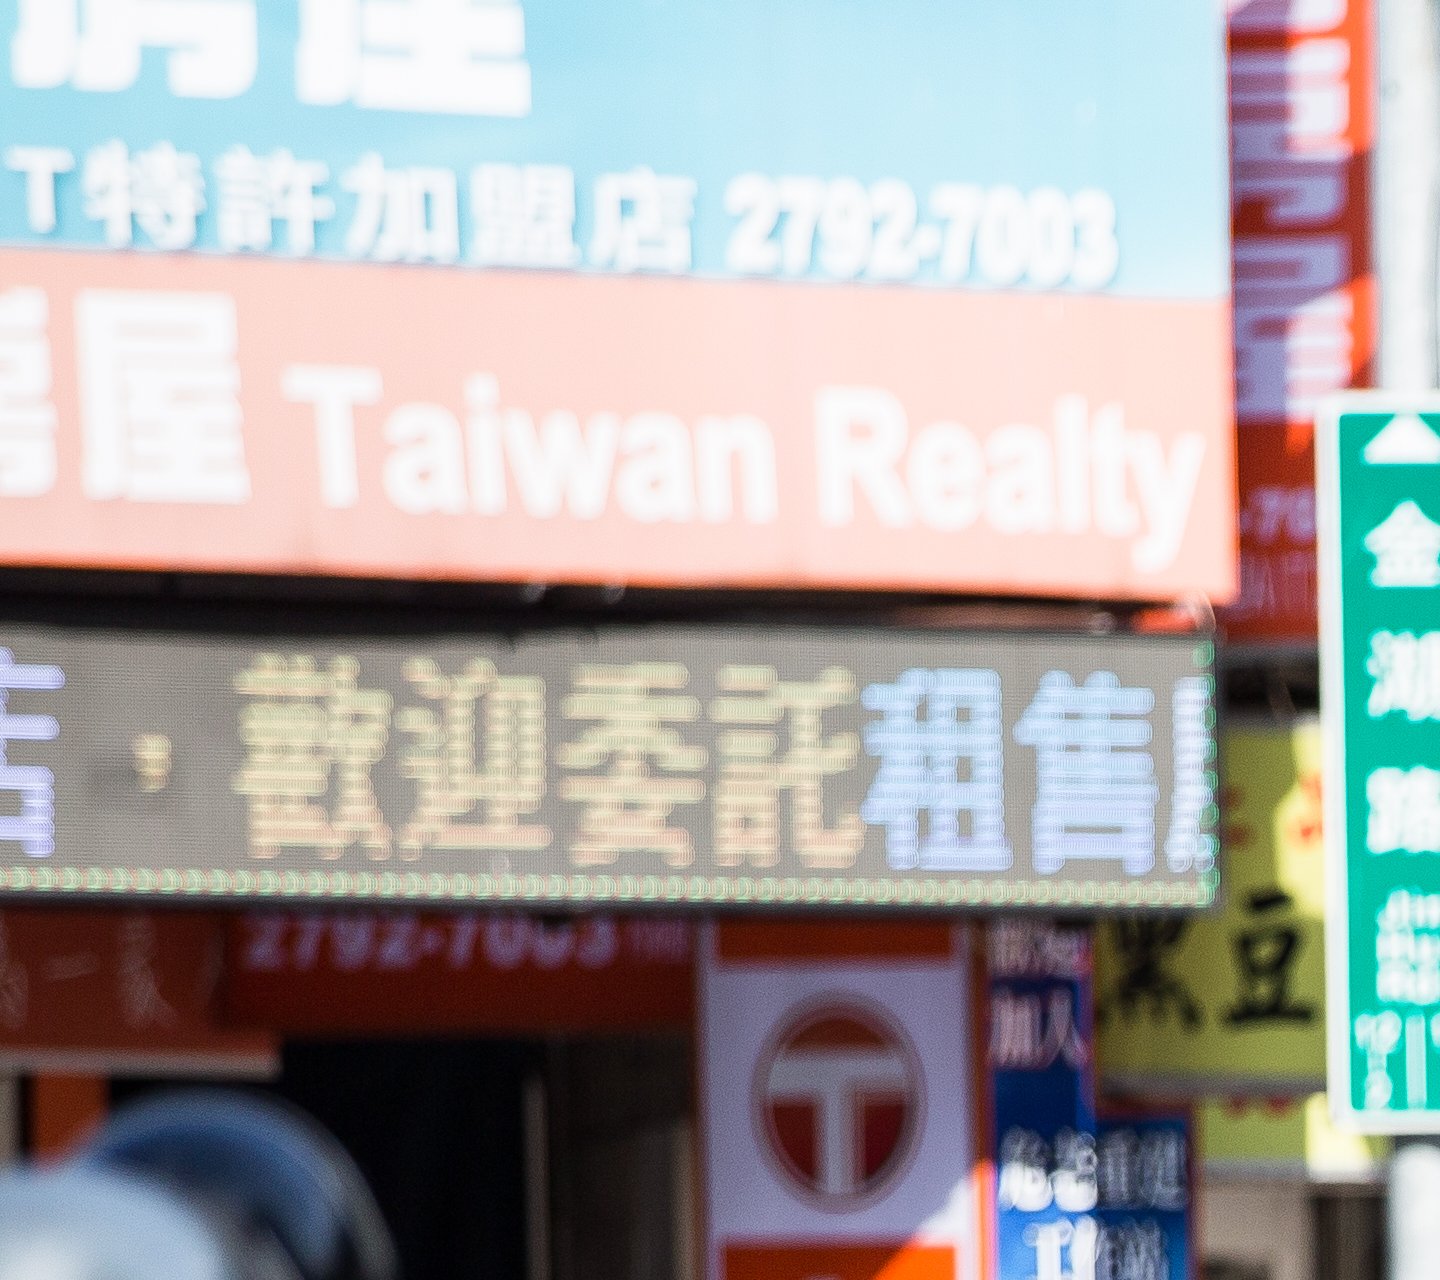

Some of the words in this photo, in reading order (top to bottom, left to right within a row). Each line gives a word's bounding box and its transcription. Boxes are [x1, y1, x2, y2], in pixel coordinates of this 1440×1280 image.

[722, 172, 1122, 289] 2792-7003
[280, 362, 780, 526] Taiwan
[811, 384, 1206, 571] Realty
